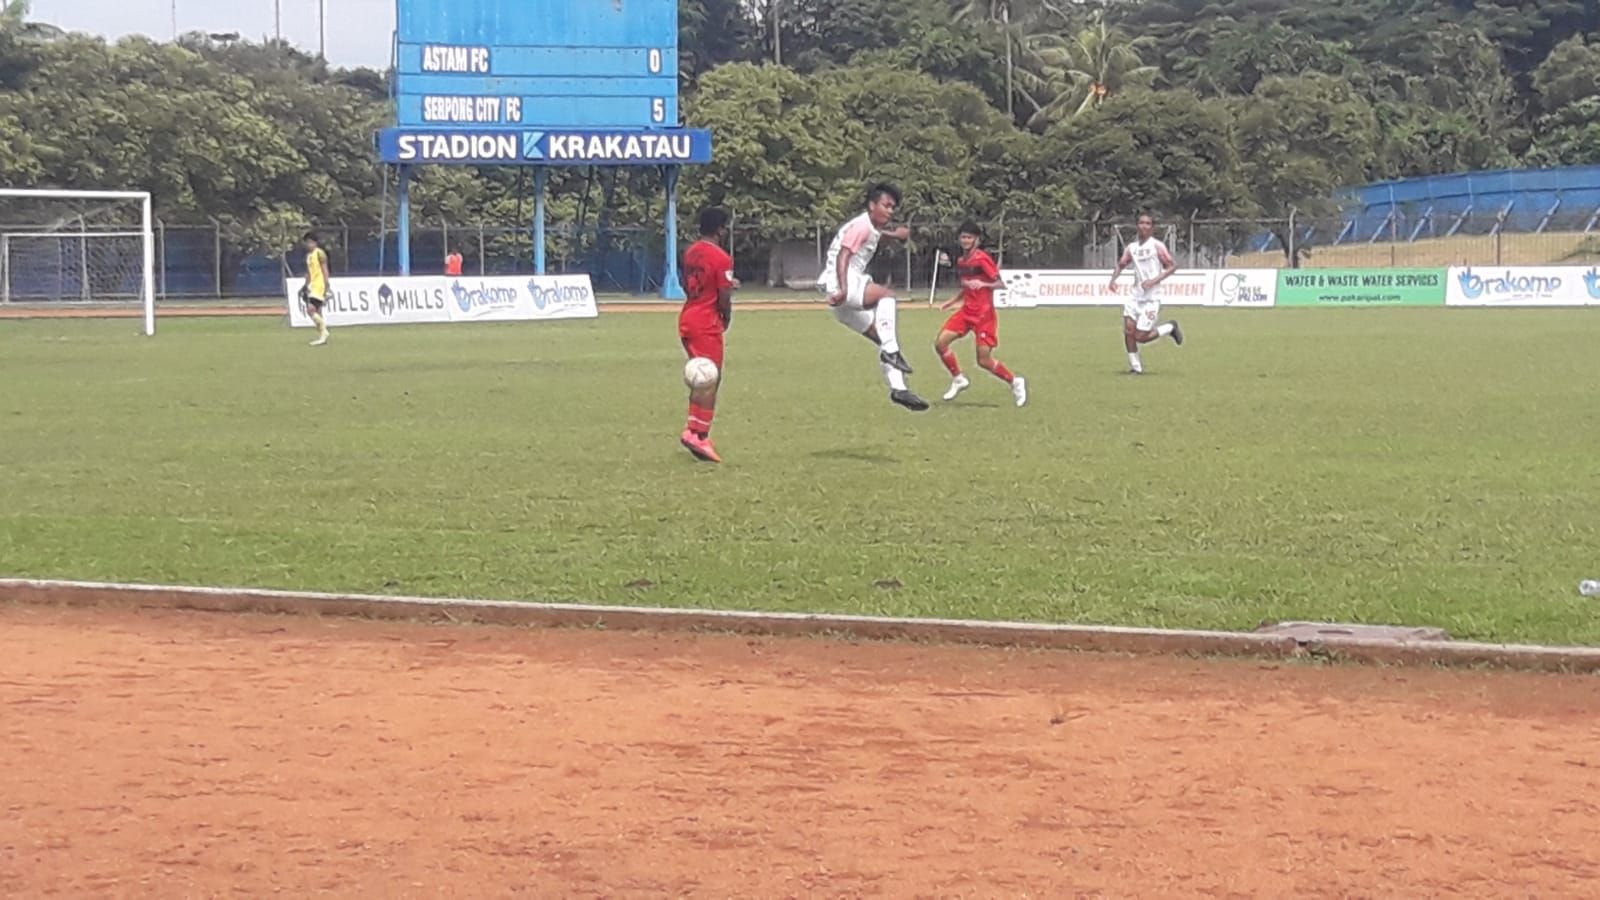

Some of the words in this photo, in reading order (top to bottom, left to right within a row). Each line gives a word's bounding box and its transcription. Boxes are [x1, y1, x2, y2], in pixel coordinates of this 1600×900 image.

[423, 46, 468, 72] ASTAM
[471, 48, 489, 73] FC
[650, 49, 660, 72] 0
[424, 96, 474, 121] SERPONG
[476, 97, 500, 122] CITY
[505, 98, 521, 122] FC
[653, 98, 663, 122] 5
[398, 135, 517, 160] STADION
[549, 135, 690, 160] KRAKATAU
[1039, 283, 1095, 297] CHEMICAL
[1285, 275, 1316, 287] WATER
[1328, 275, 1358, 287] WASTE
[1362, 275, 1393, 287] WATER
[1395, 274, 1439, 287] SERVICES
[397, 287, 444, 311] MILLS
